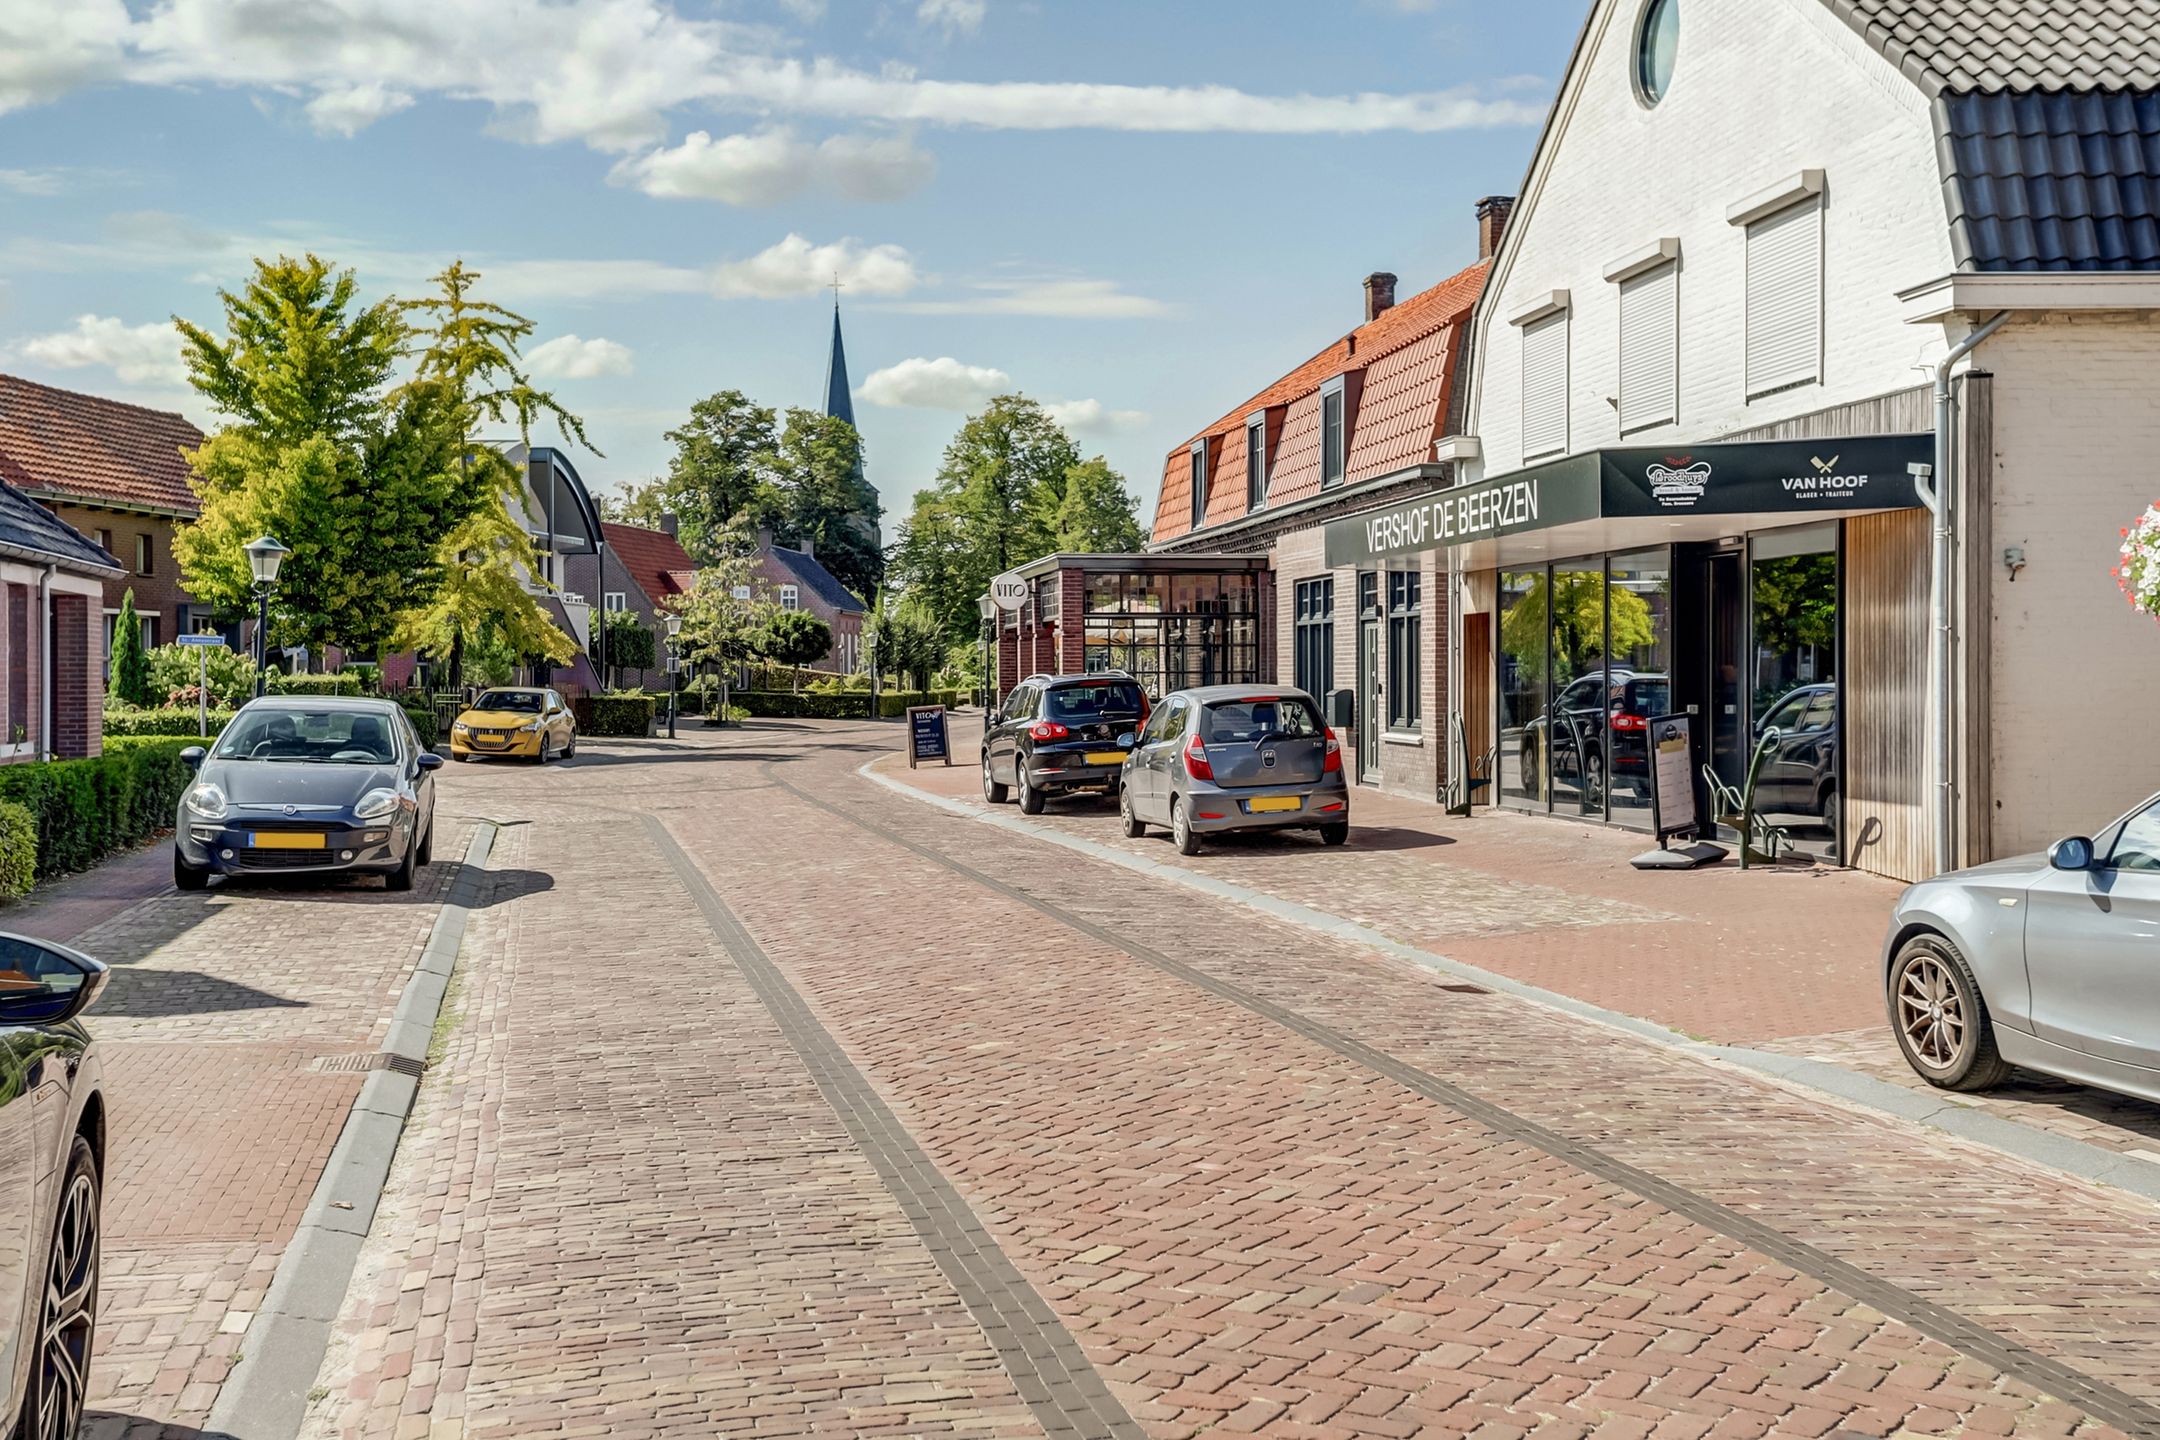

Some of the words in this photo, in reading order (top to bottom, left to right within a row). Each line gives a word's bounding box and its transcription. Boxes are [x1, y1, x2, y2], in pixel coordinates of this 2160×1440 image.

[1655, 470, 1704, 484] Broodhuys
[1781, 477, 1816, 490] VAN
[1820, 475, 1868, 489] HOOF
[1796, 491, 1817, 499] SLAGER
[1826, 490, 1854, 498] TRAITEUR
[1366, 506, 1430, 553] VERSHOF
[1434, 500, 1455, 540] DE
[1458, 479, 1538, 535] BEERZEN
[997, 584, 1025, 597] VITO
